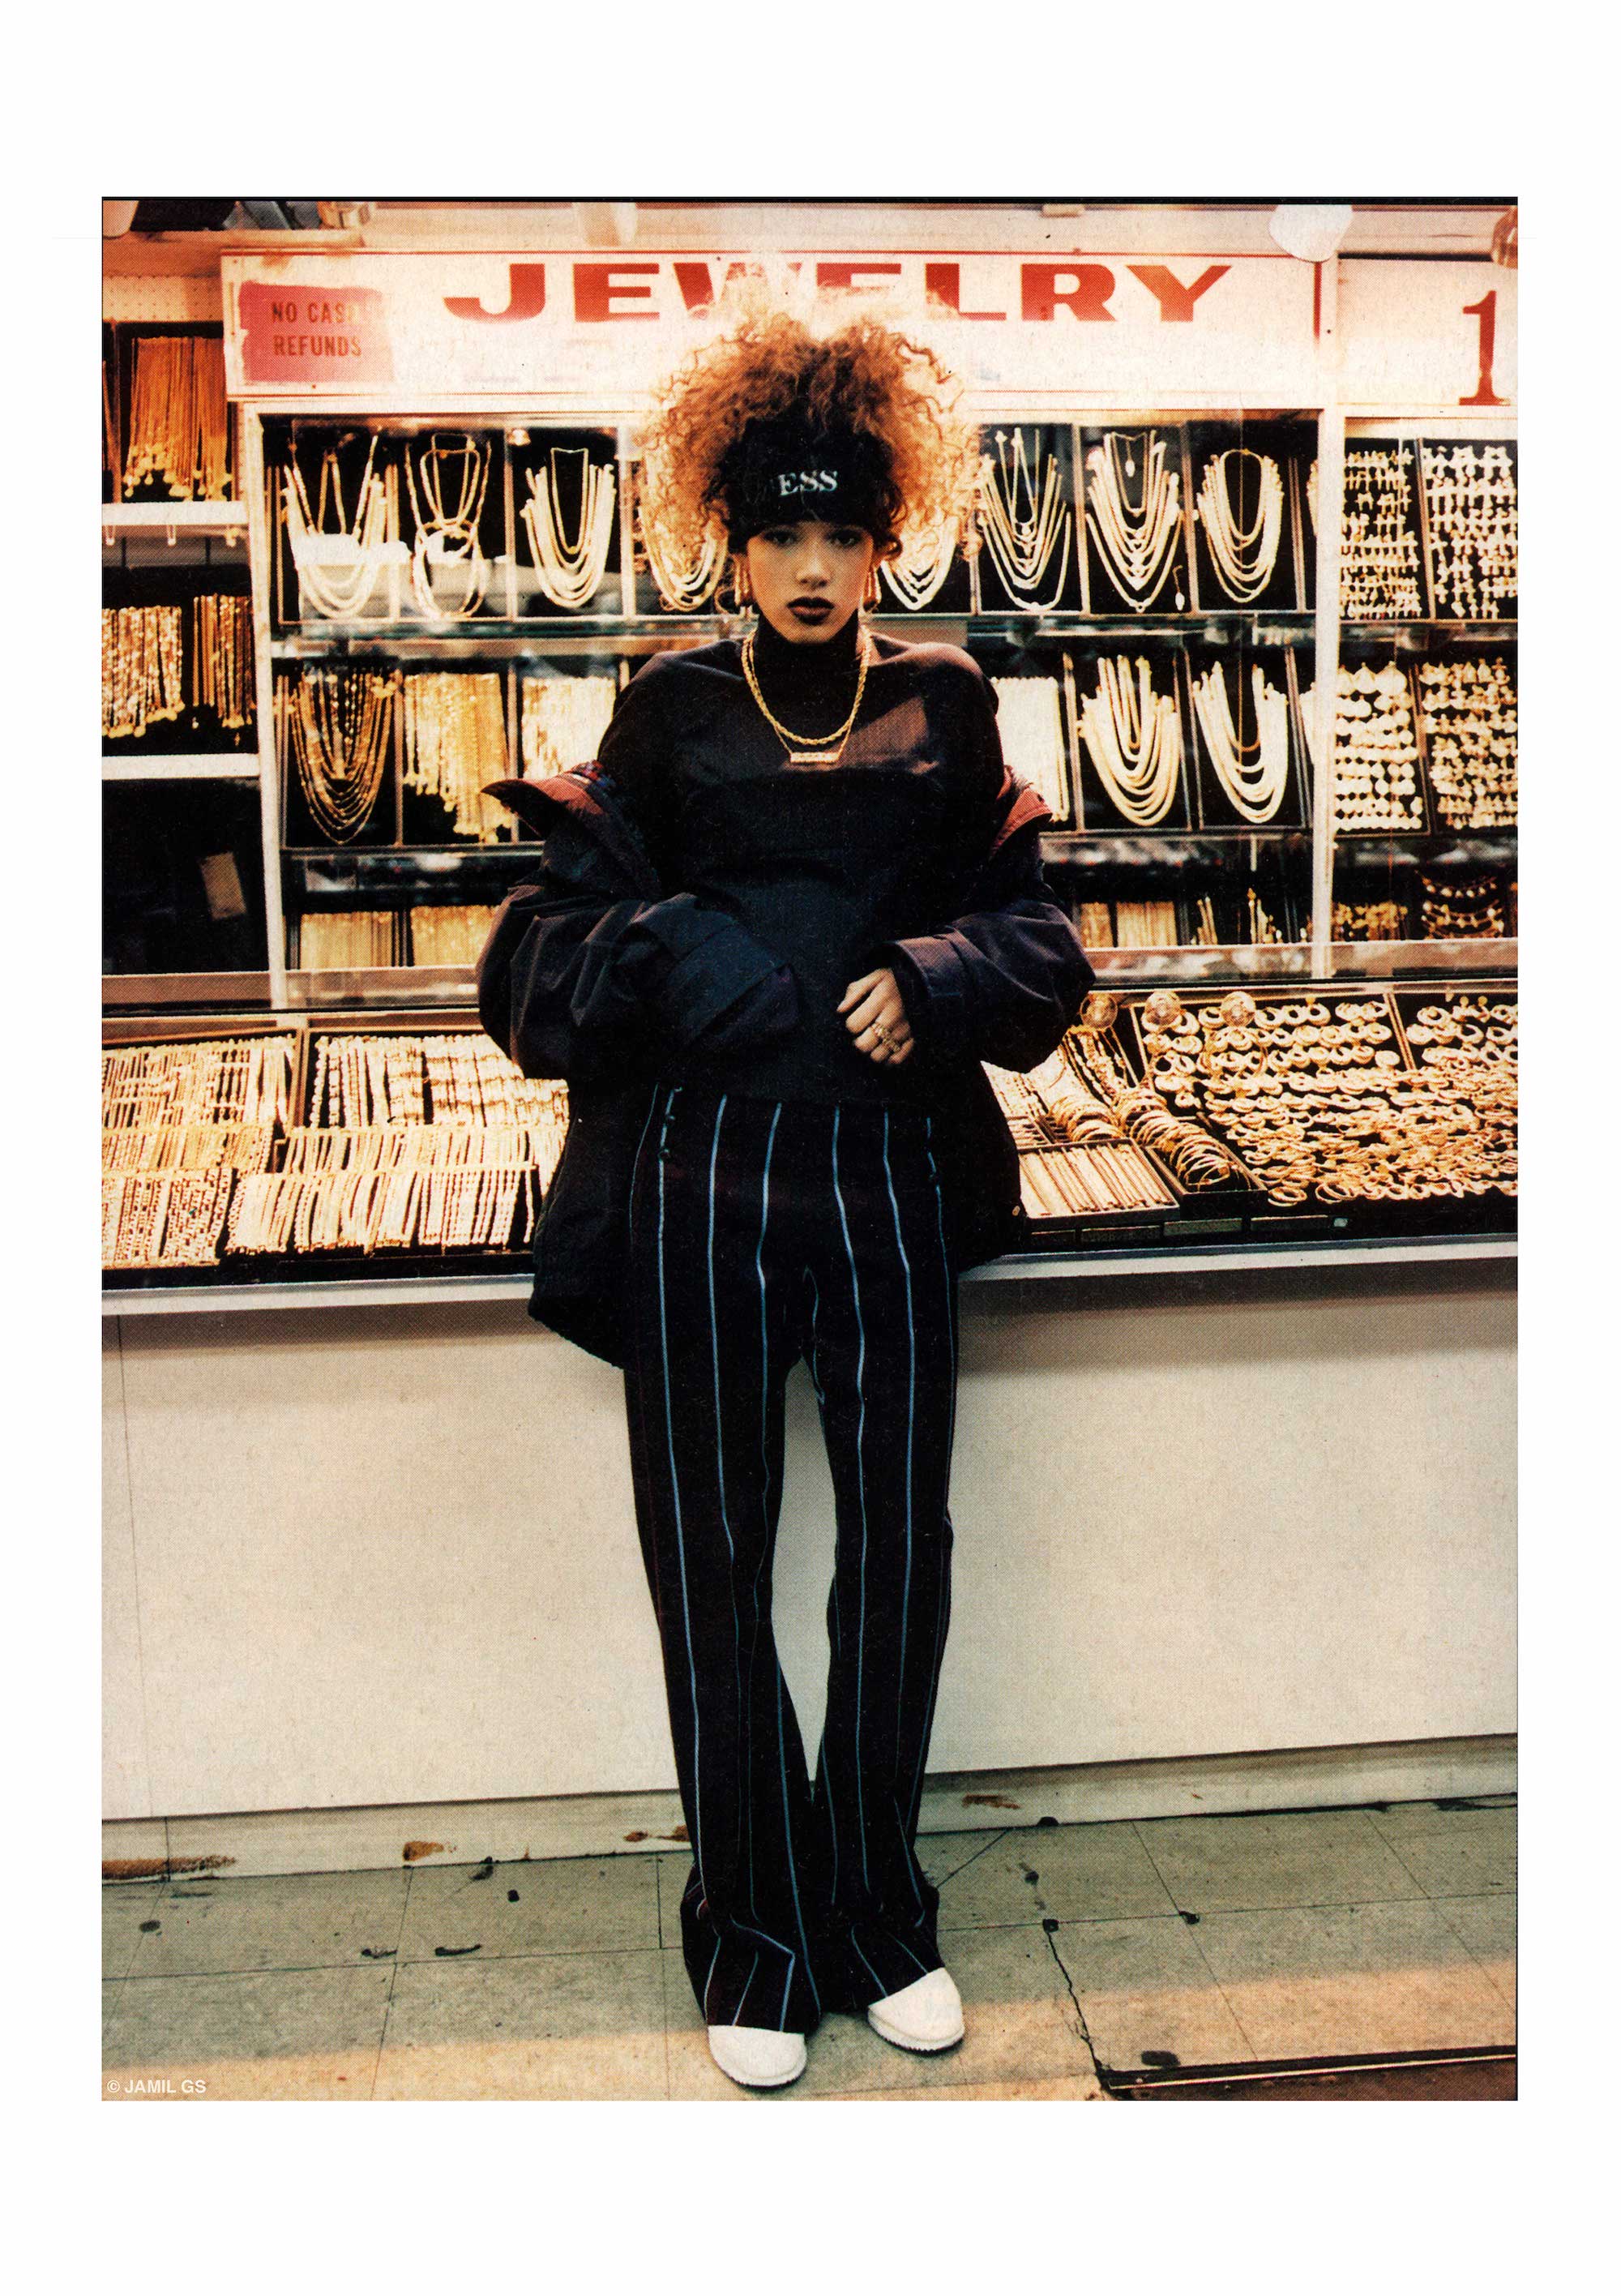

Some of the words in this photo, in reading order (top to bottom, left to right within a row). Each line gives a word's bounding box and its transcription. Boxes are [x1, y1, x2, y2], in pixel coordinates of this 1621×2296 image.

[272, 302, 297, 323] NO
[273, 335, 361, 357] REFUNDS
[1459, 290, 1511, 406] 1
